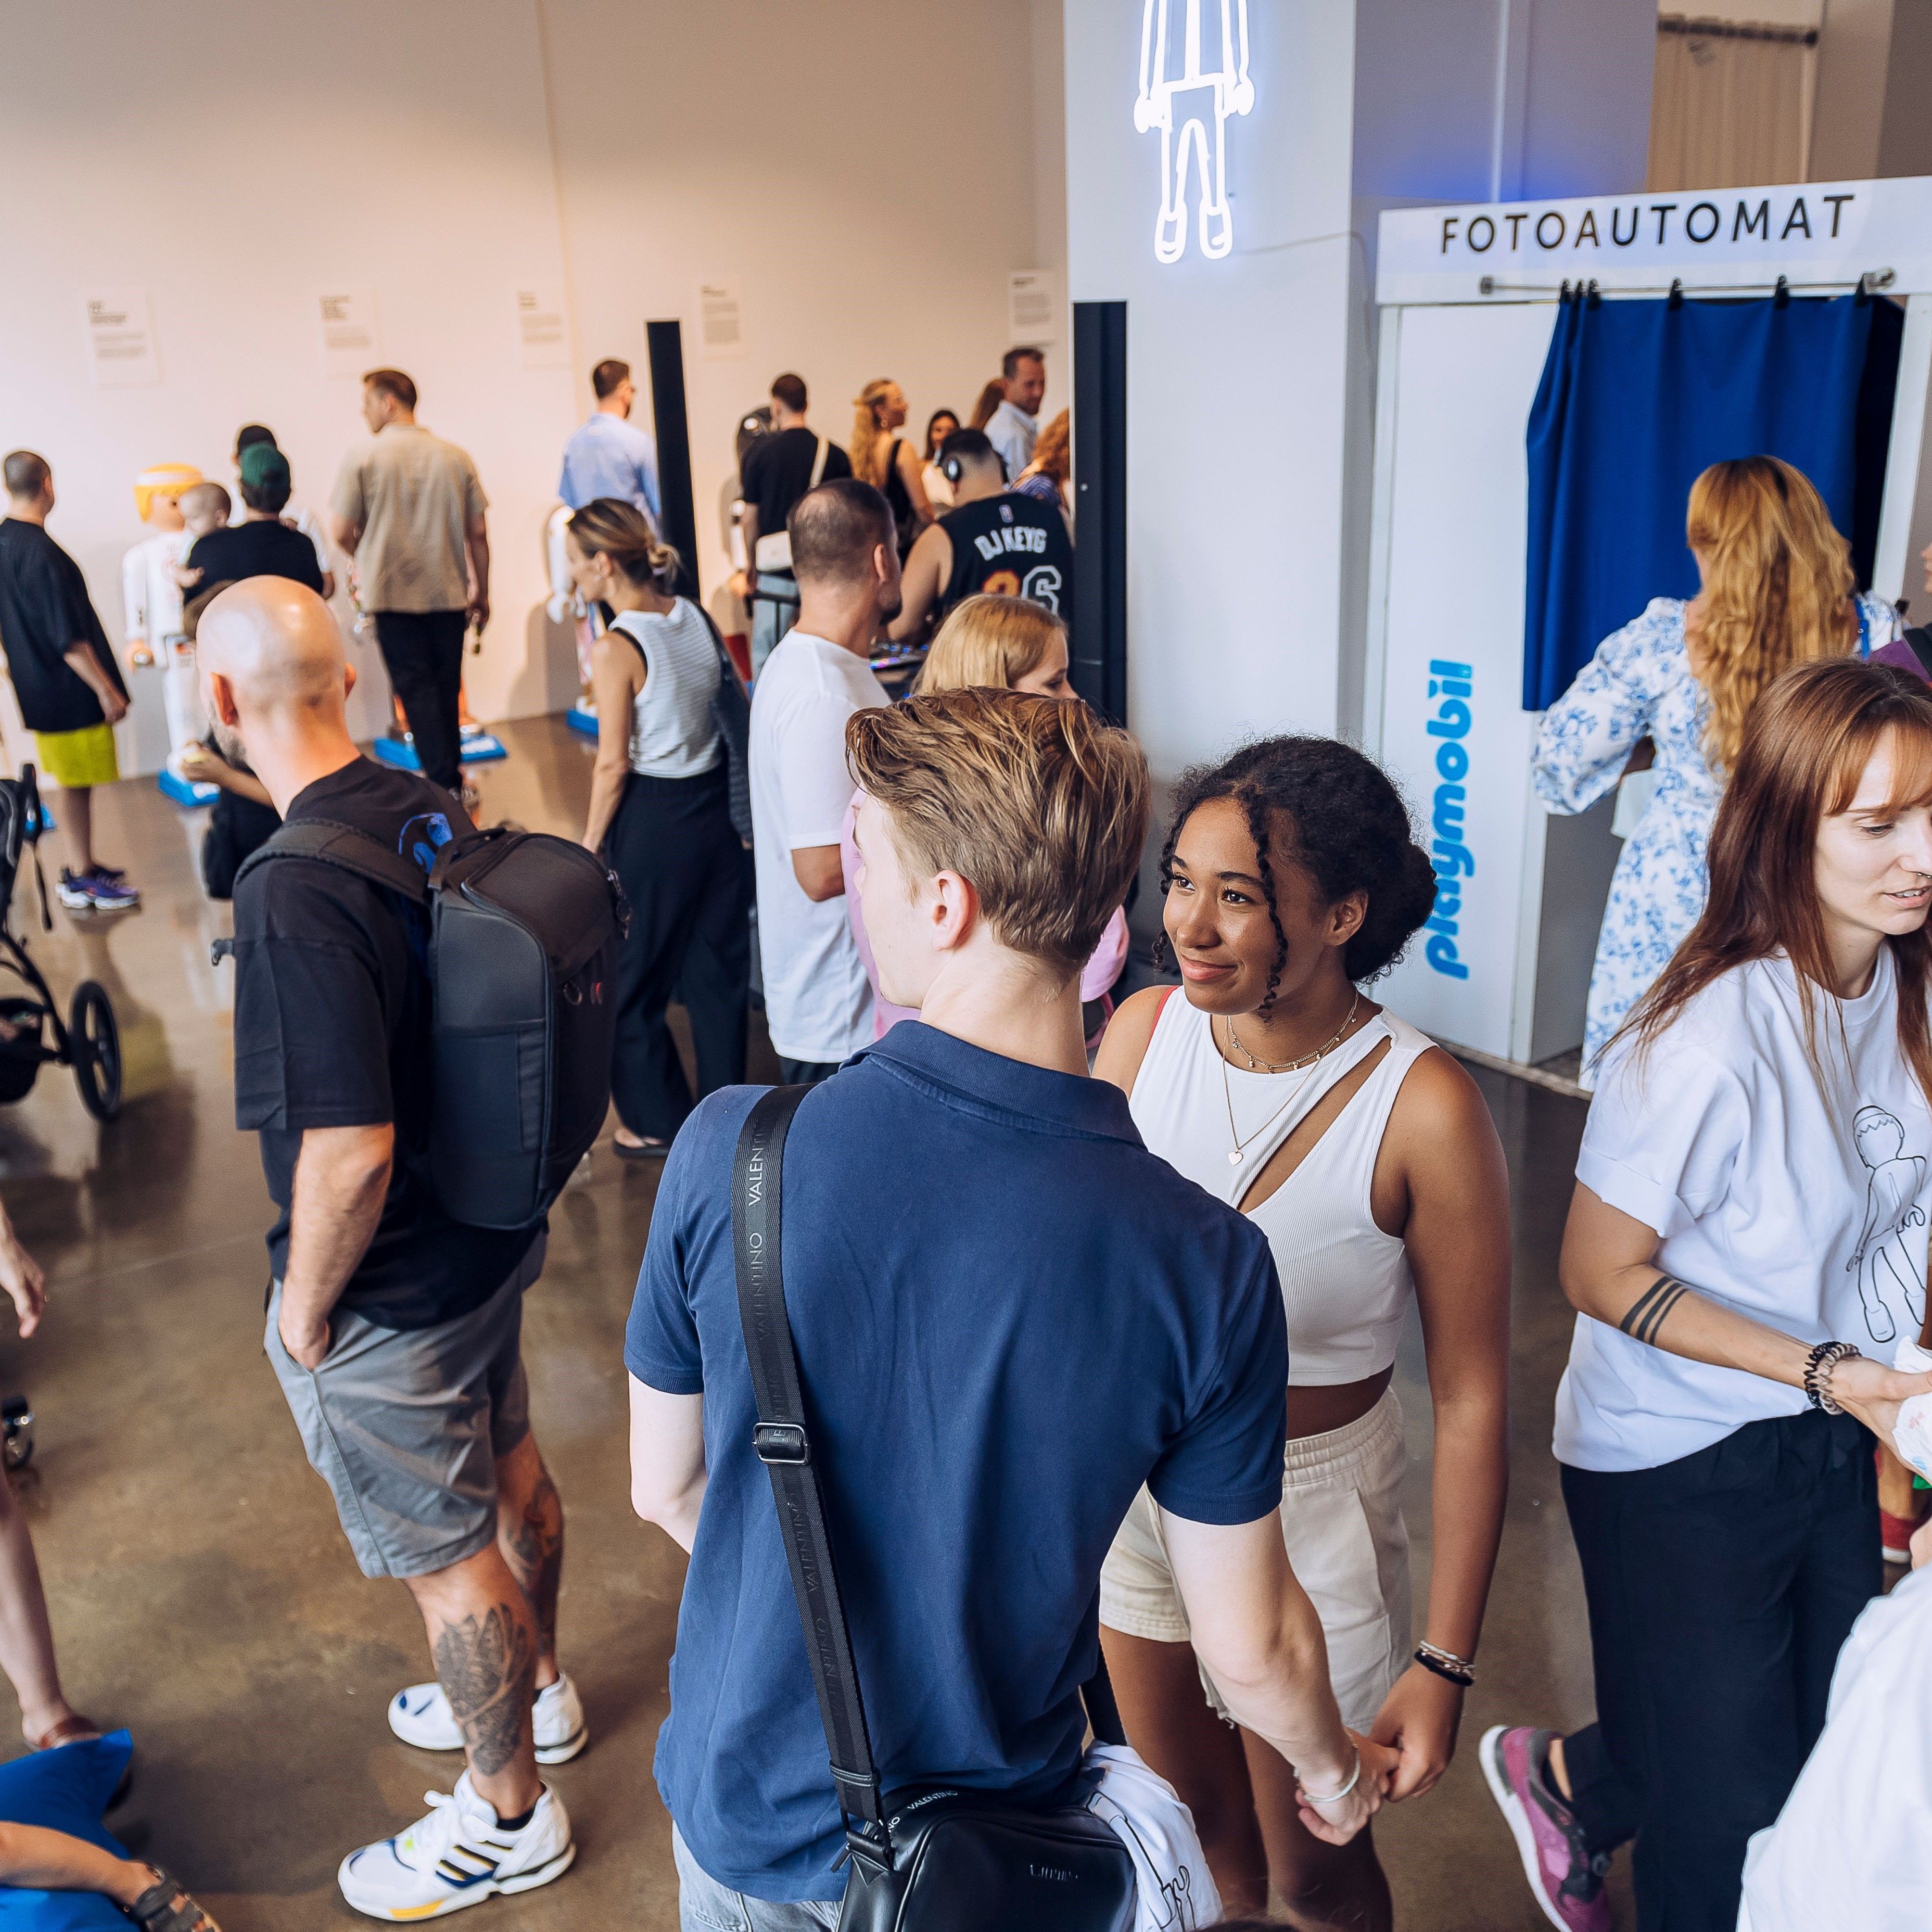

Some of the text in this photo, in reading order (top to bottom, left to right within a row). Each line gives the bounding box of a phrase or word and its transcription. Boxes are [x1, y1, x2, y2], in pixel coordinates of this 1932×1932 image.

[1441, 194, 1856, 254] FOTOAUTOMAT
[1424, 659, 1475, 980] playmobil
[907, 1790, 958, 1810] VALENTINO
